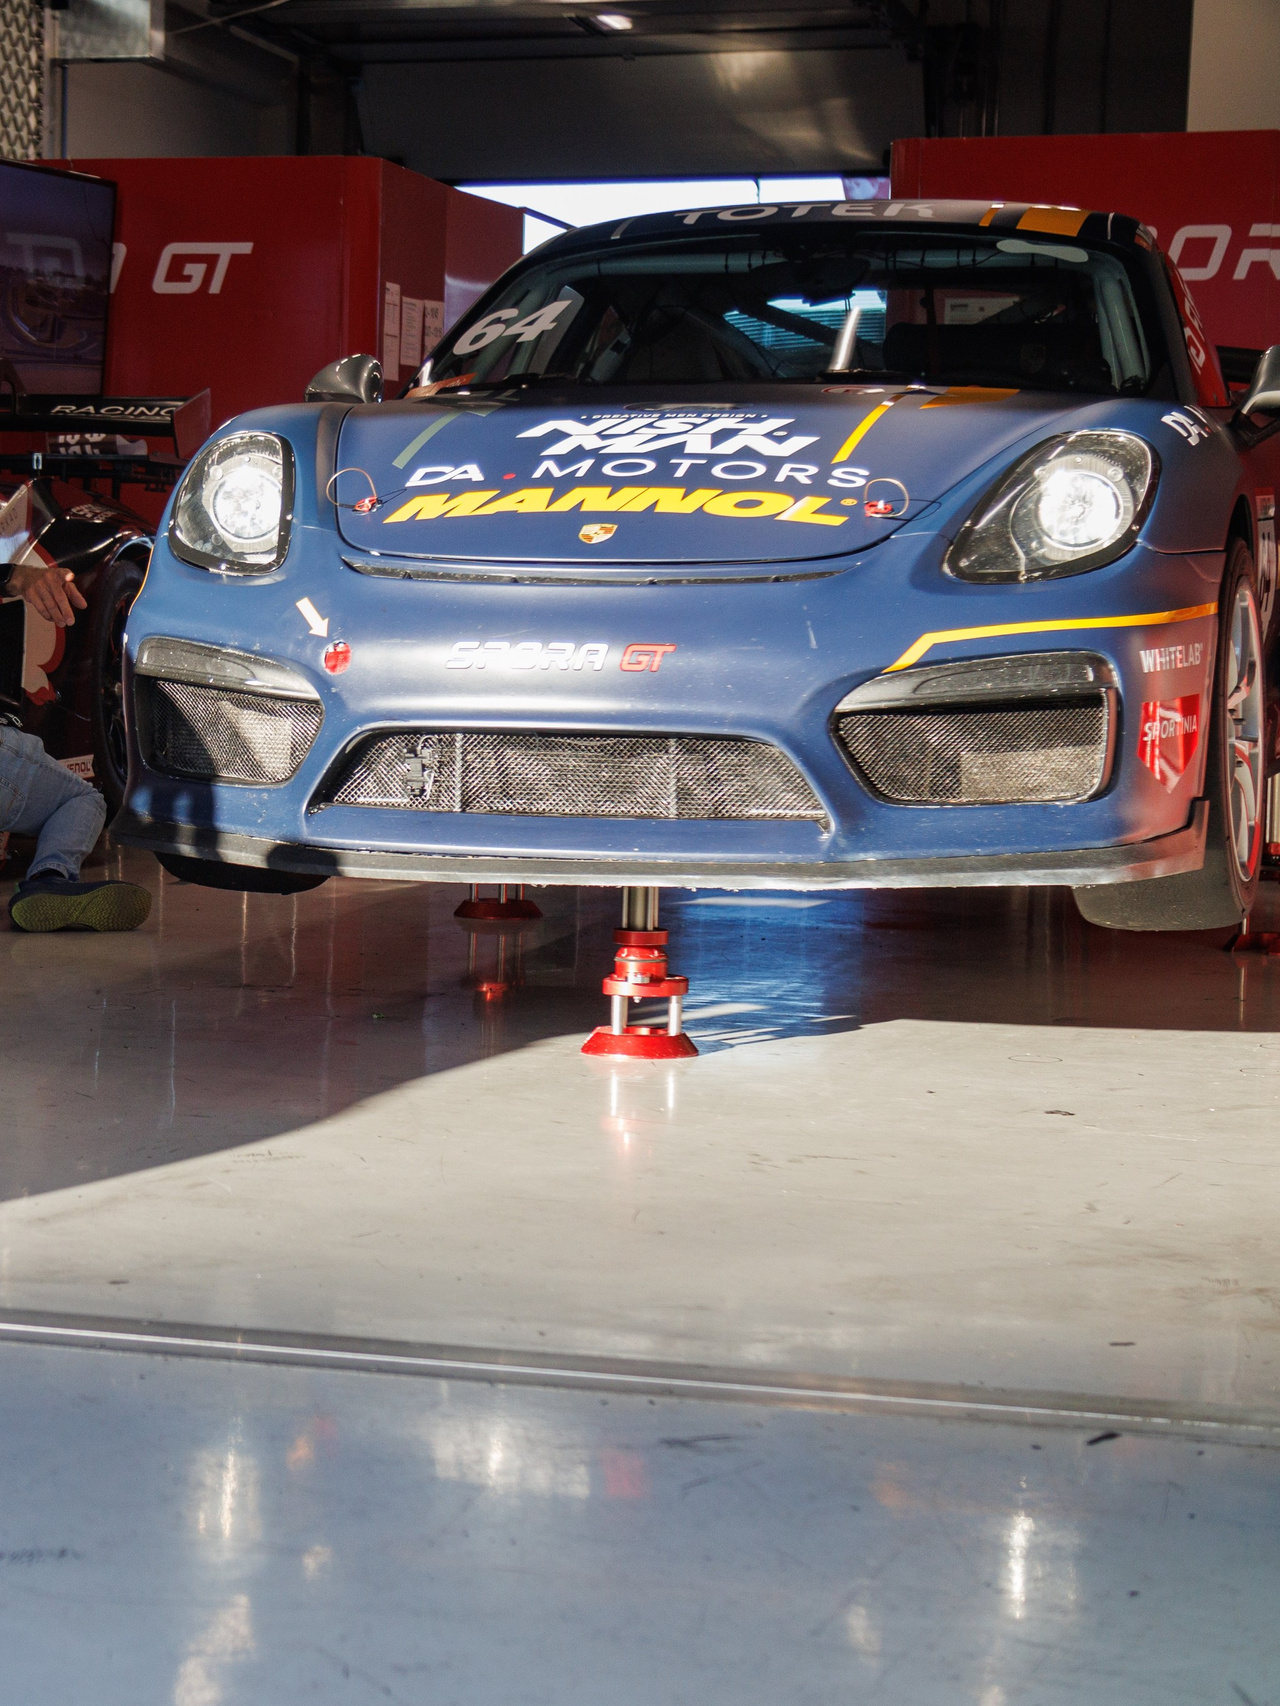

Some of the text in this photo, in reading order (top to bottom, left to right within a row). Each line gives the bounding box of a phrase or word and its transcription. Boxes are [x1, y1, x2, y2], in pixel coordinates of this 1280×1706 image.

[152, 242, 254, 295] GT
[452, 299, 573, 356] 64
[531, 459, 871, 488] MOTORS
[382, 487, 850, 527] MANNOL
[445, 641, 677, 672] SPORA GT
[1139, 644, 1202, 674] WHITELAB
